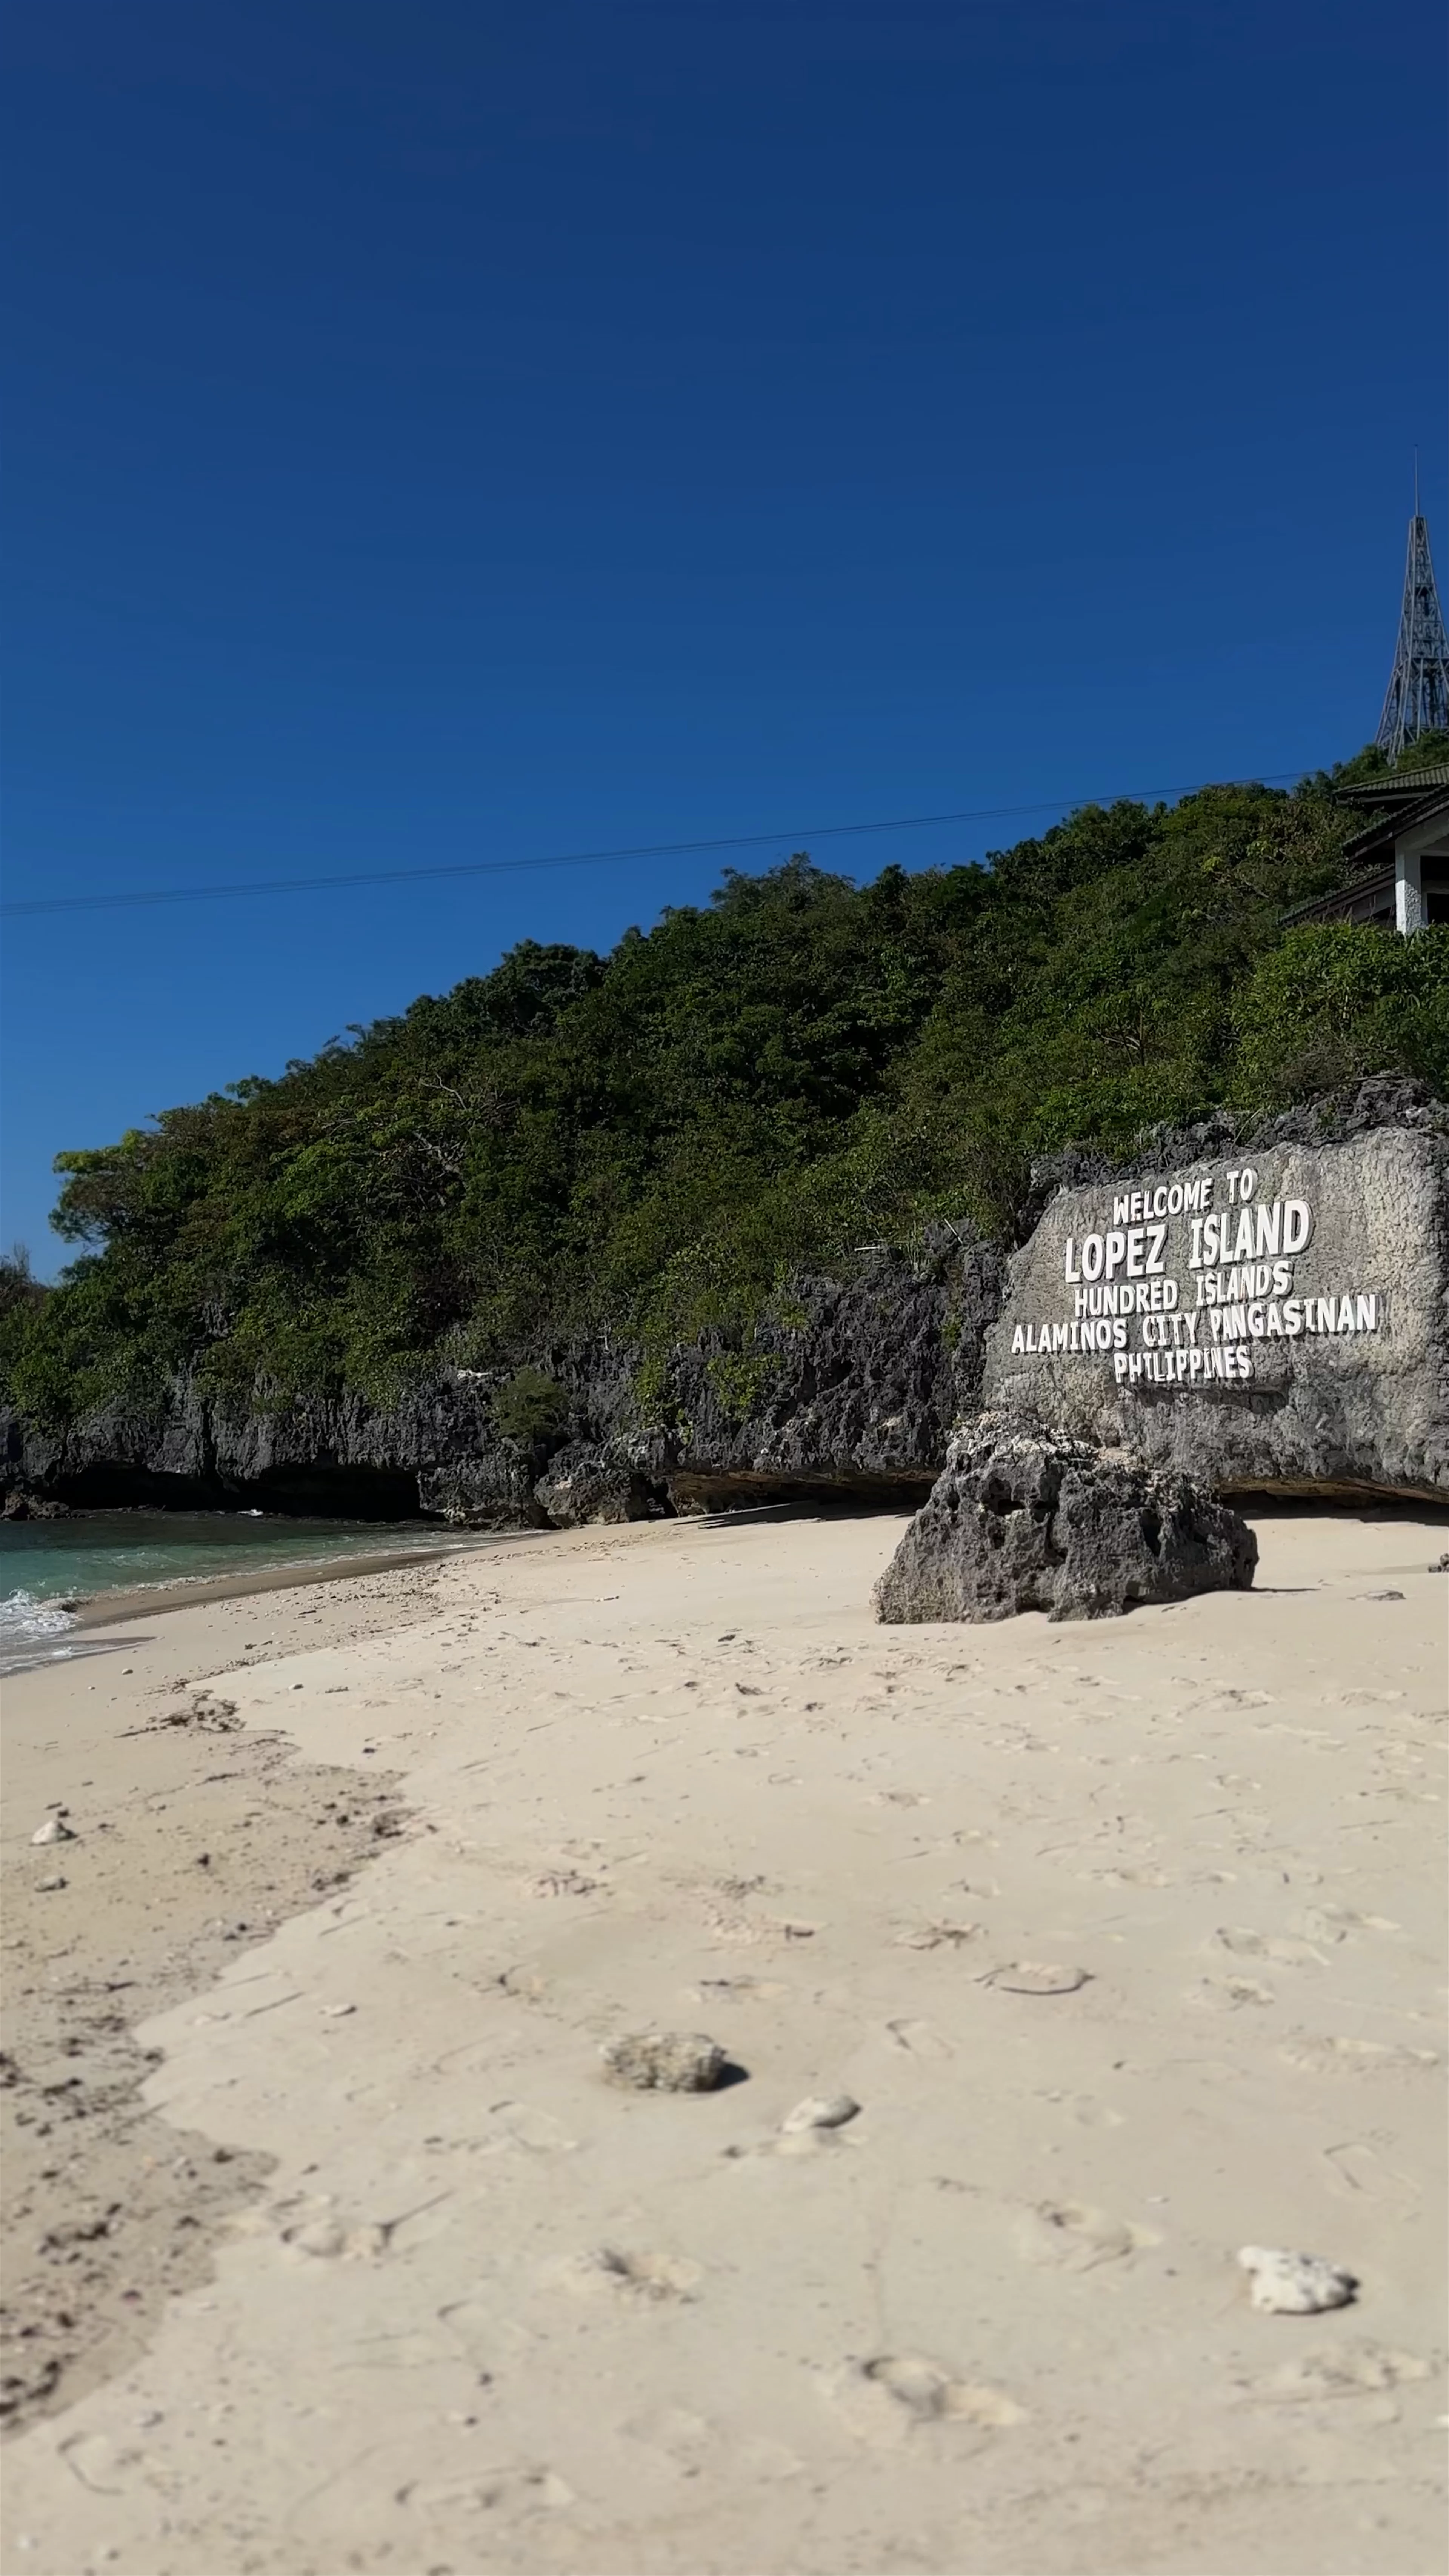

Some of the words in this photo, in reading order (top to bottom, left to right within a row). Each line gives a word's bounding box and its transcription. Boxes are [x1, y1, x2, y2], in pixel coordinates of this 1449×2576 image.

[1113, 1178, 1212, 1225] WELCOME
[1227, 1168, 1258, 1203] TO
[1065, 1224, 1168, 1283] LOPEZ
[1189, 1200, 1313, 1269] ISLAND
[1075, 1280, 1178, 1317] HUNDRED
[1196, 1261, 1293, 1306] ISLANDS
[1012, 1319, 1128, 1353] ALAMINOS
[1143, 1312, 1201, 1347] CITY
[1211, 1295, 1378, 1341] PANGASINAN
[1114, 1346, 1253, 1383] PHILIPPINES
